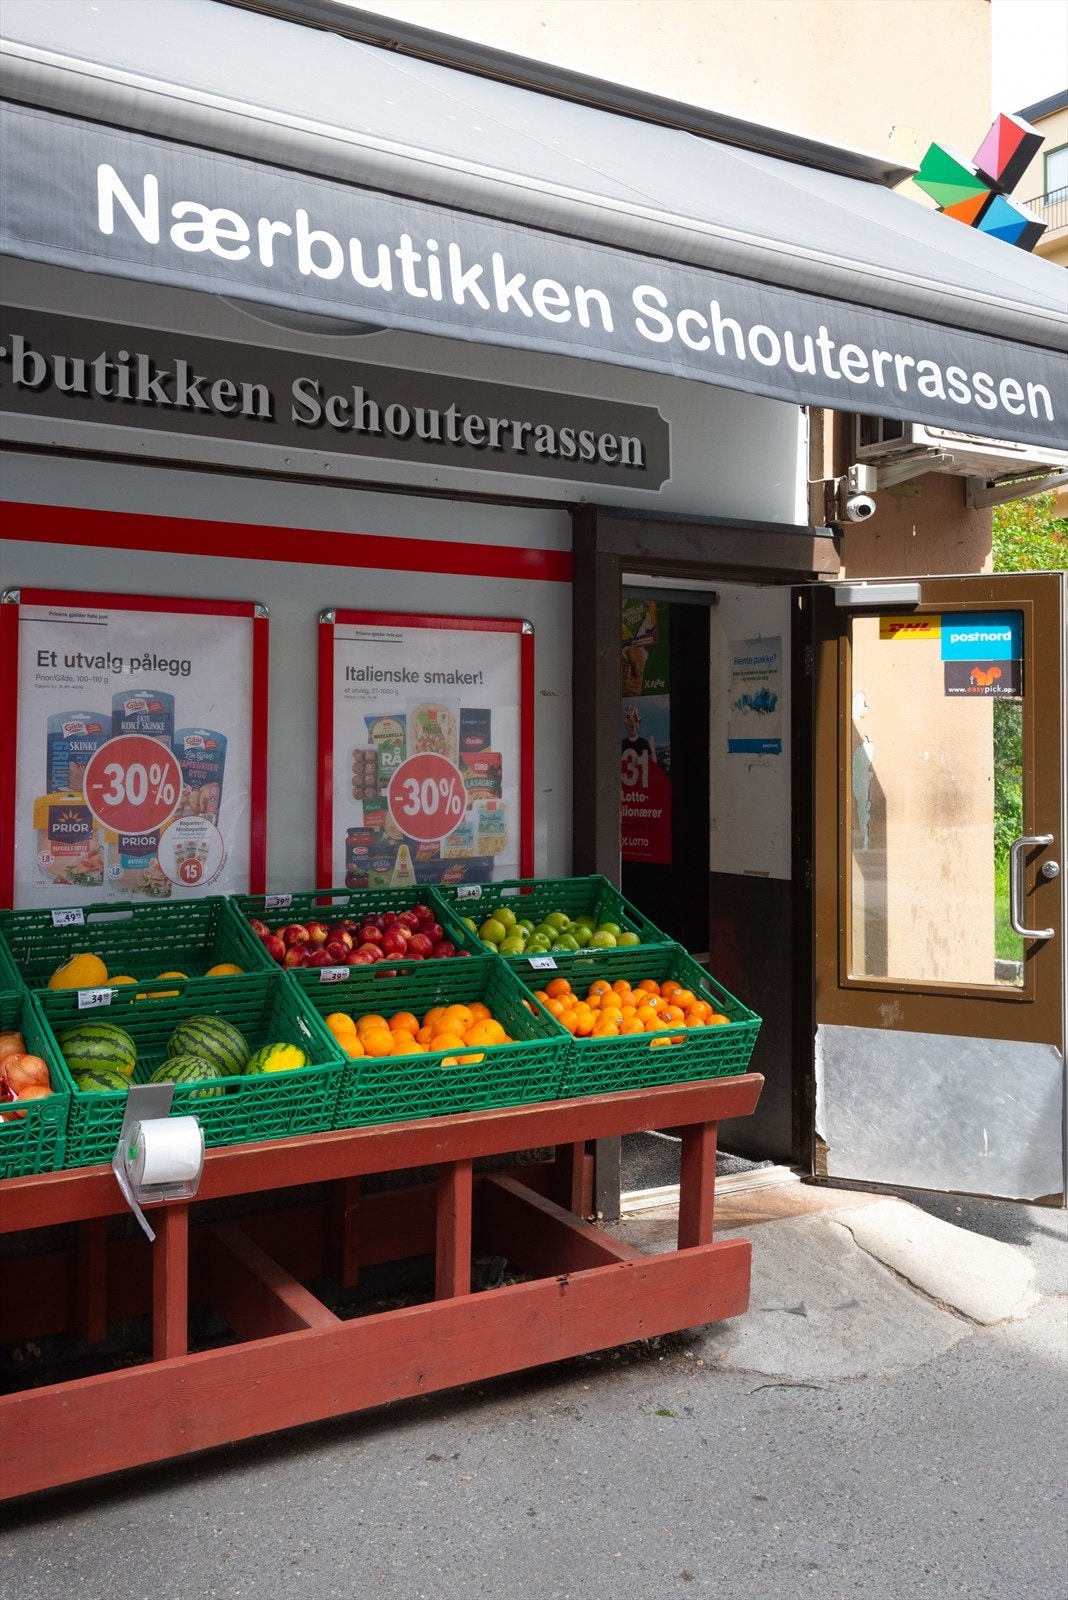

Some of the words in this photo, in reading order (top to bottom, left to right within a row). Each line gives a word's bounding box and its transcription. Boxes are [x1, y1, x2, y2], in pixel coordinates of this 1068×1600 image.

[97, 164, 613, 332] Nærbutikken
[631, 284, 1054, 422] Schouterrassen
[291, 377, 645, 467] Schouterrassen
[888, 622, 931, 633] DHL
[950, 630, 1011, 644] postnord
[37, 650, 58, 668] Et
[64, 652, 123, 674] utvalg
[129, 653, 191, 676] pålegg
[734, 656, 752, 665] Hente
[753, 654, 776, 665] pakke?
[104, 676, 109, 684] g
[345, 666, 420, 683] Italienske
[424, 669, 483, 685] smaker!
[622, 748, 649, 788] 31
[92, 763, 175, 806] -30%
[394, 778, 462, 816] -30%
[622, 806, 662, 818] lionærer
[52, 824, 89, 832] PRIOR
[122, 837, 156, 846] PRIOR
[628, 838, 649, 847] LOTTO
[184, 864, 198, 878] 15
[276, 898, 285, 906] 39
[65, 914, 76, 922] 49
[92, 994, 103, 1004] 34
